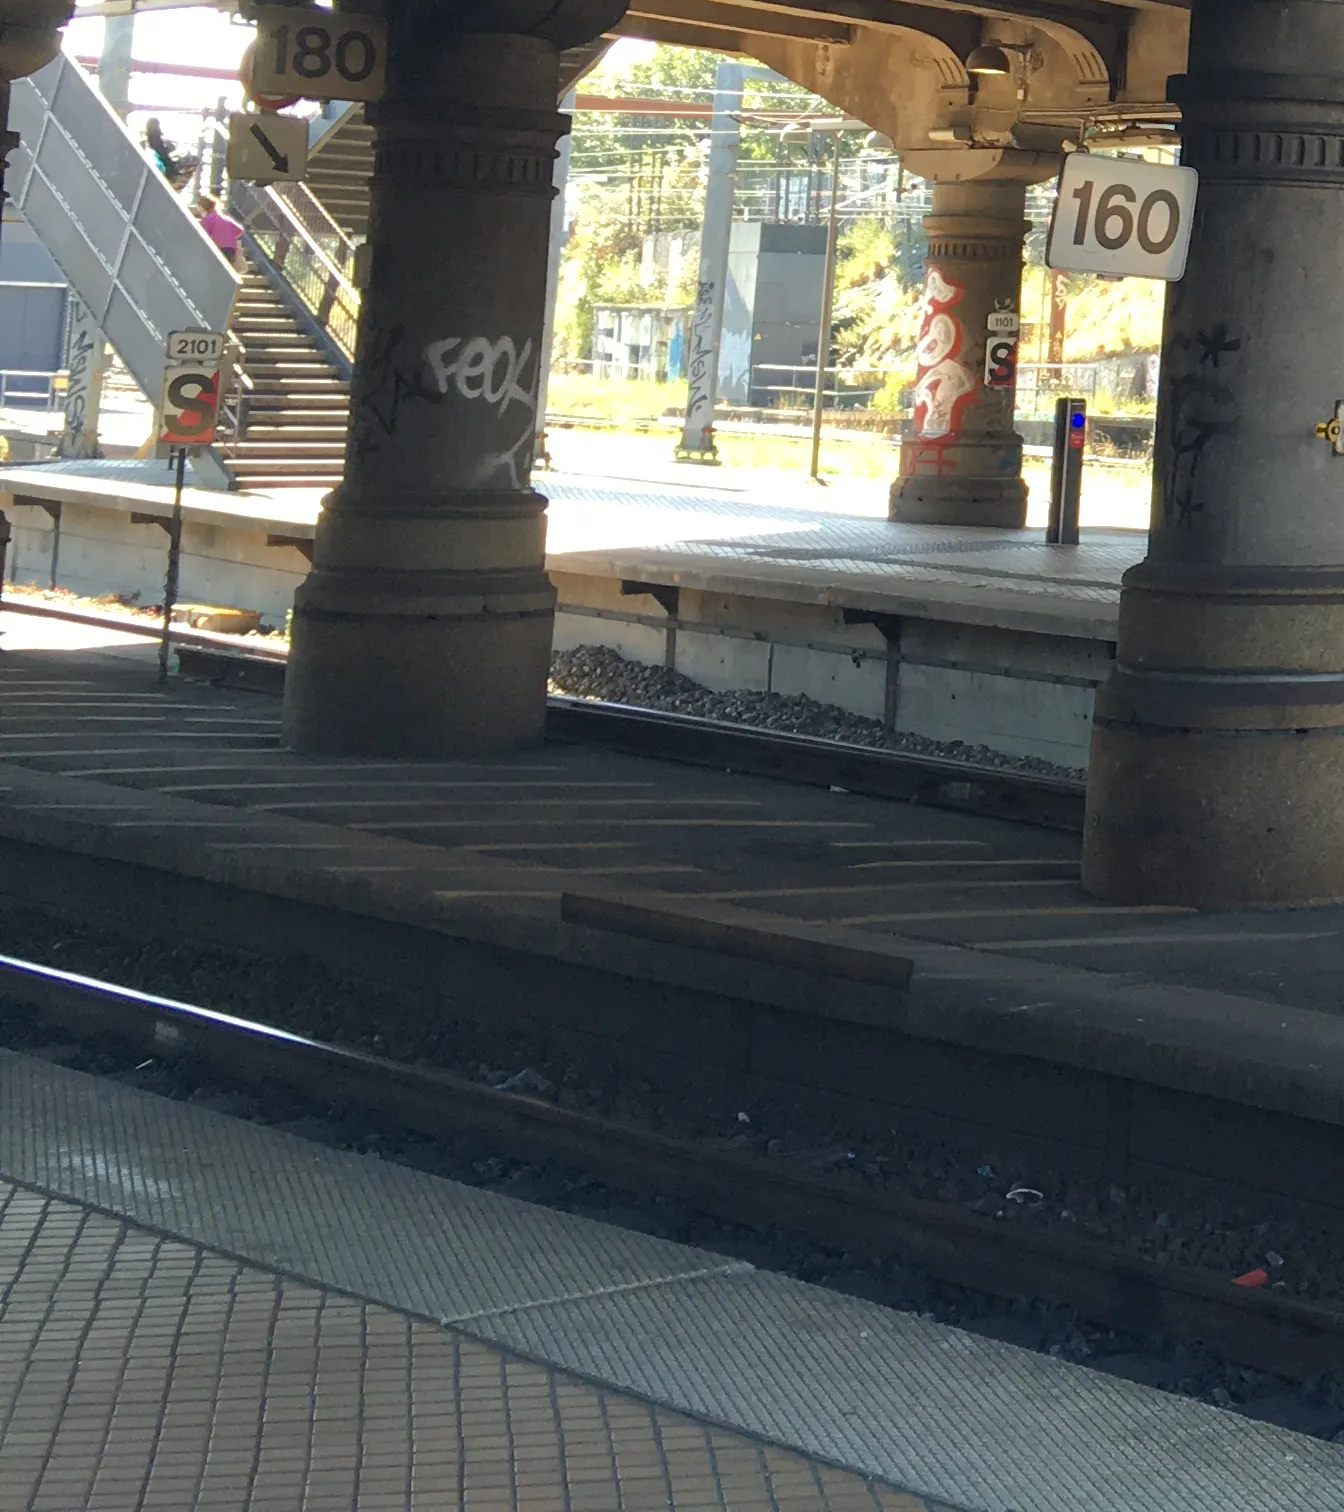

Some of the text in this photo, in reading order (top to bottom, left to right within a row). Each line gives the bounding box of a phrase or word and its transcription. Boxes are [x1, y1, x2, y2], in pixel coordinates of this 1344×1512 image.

[273, 24, 377, 83] 180
[1072, 180, 1180, 255] 160
[177, 339, 217, 355] 2101
[995, 317, 1013, 328] 1101
[989, 342, 1014, 381] S
[165, 373, 216, 436] S
